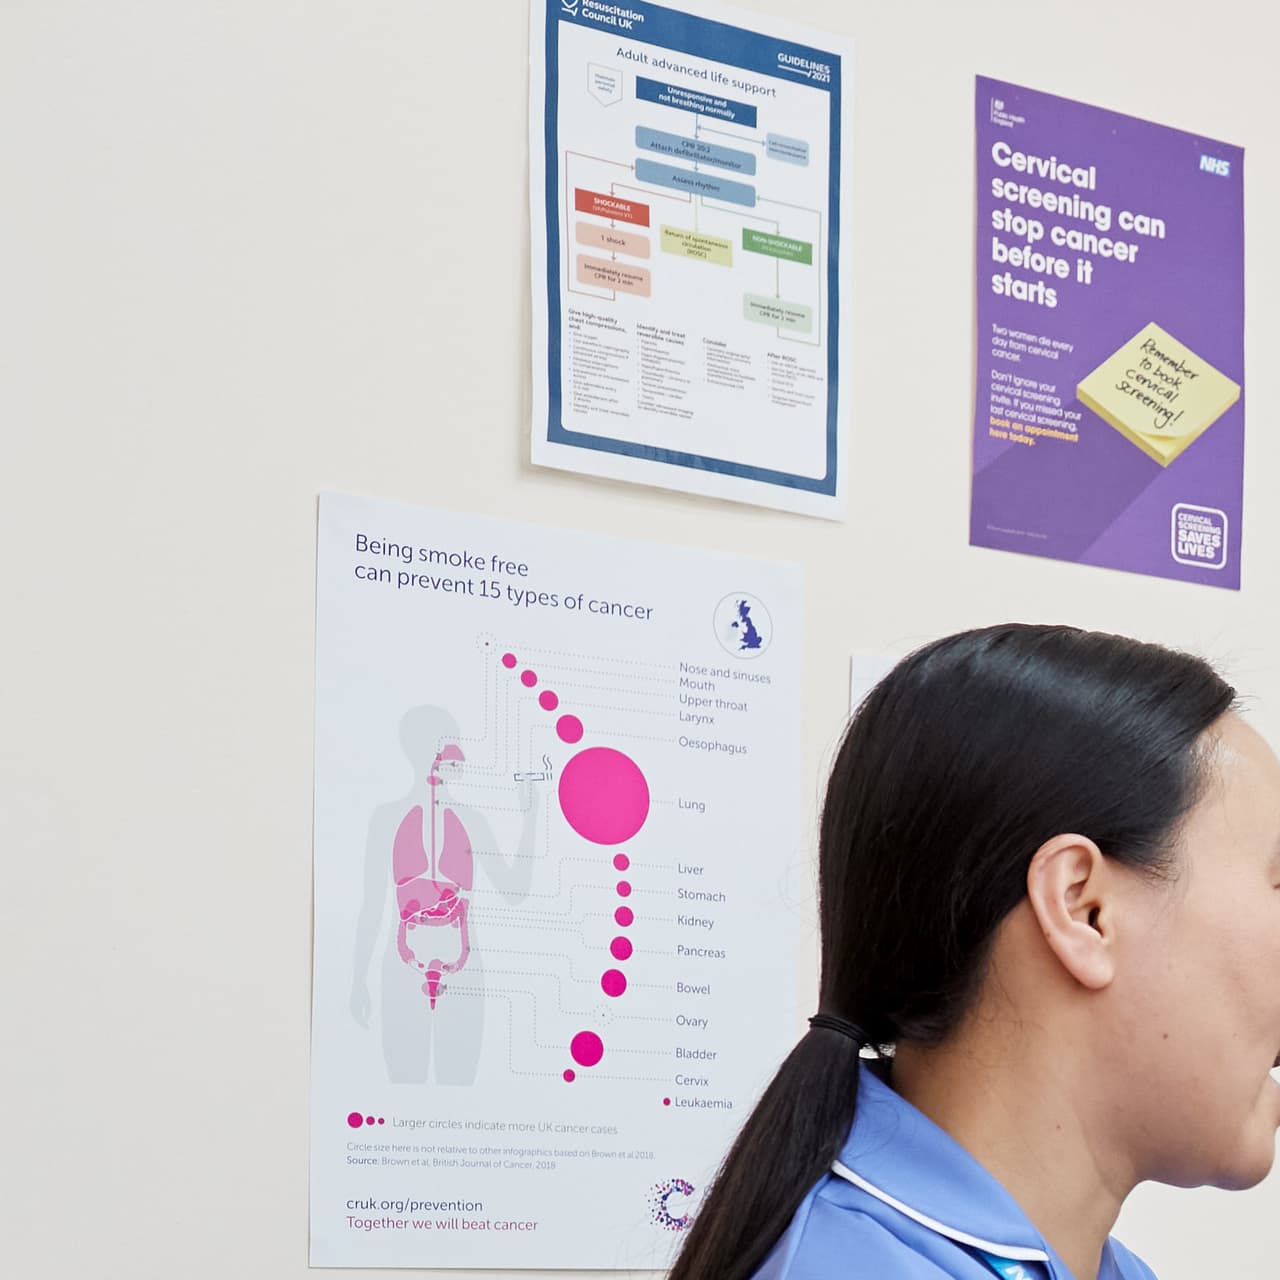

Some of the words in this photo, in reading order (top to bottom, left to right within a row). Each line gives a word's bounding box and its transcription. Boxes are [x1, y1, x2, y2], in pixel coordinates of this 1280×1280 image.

[582, 0, 645, 22] Resuscitation
[582, 8, 617, 26] Council
[618, 18, 633, 30] UK
[616, 47, 649, 64] Adult
[651, 58, 708, 80] advanced
[710, 71, 729, 86] life
[731, 79, 777, 98] support
[777, 52, 831, 74] GUIDELINES
[811, 71, 830, 83] 2021
[658, 94, 671, 103] not
[671, 95, 705, 112] breathing
[667, 86, 713, 104] Unresponsive
[991, 141, 1096, 191] Cervical
[1200, 155, 1230, 176] NHS
[991, 177, 1112, 232] screening
[1118, 210, 1166, 240] can
[991, 207, 1045, 244] stop
[1050, 225, 1139, 264] cancer
[991, 236, 1071, 279] before
[1076, 258, 1094, 285] it
[991, 271, 1058, 309] starts
[991, 323, 1008, 336] Two
[1008, 329, 1038, 343] women
[1038, 336, 1052, 347] die
[1052, 339, 1074, 353] every
[991, 336, 1008, 349] day
[1008, 339, 1027, 352] from
[1027, 345, 1059, 360] cervical
[1139, 338, 1199, 380] Remember
[1139, 357, 1152, 371] to
[1152, 365, 1182, 391] book
[1178, 529, 1222, 549] SAVES
[355, 533, 414, 564] Being
[418, 547, 486, 571] smoke
[490, 555, 529, 577] free
[1177, 541, 1216, 559] LIVES
[354, 565, 392, 583] can
[397, 571, 475, 596] prevent
[479, 579, 501, 599] 15
[506, 584, 559, 608] types
[563, 593, 584, 611] of
[587, 599, 654, 621] cancer
[679, 661, 708, 677] Nose
[709, 667, 731, 679] and
[732, 671, 772, 685] sinuses
[679, 677, 716, 692] Mouth
[679, 693, 713, 708] Upper
[715, 698, 749, 713] throat
[679, 710, 715, 726] Larynx
[678, 735, 748, 756] Oesophagus
[678, 797, 706, 814] Lung
[677, 862, 705, 876] Liver
[677, 887, 727, 904] Stomach
[677, 914, 715, 931] Kidney
[677, 944, 726, 960] Pancreas
[676, 981, 711, 996] Bowel
[675, 1014, 709, 1030] Ovary
[675, 1047, 717, 1061] Bladder
[675, 1073, 710, 1087] Cervix
[675, 1096, 733, 1110] Leukaemia
[392, 1116, 426, 1130] Larger
[428, 1118, 463, 1130] circles
[465, 1119, 506, 1132] indicate
[508, 1122, 536, 1133] more
[537, 1122, 553, 1133] UK
[554, 1123, 590, 1134] cancer
[591, 1125, 619, 1135] cases
[346, 1141, 373, 1153] Circle
[373, 1143, 391, 1153] size
[391, 1143, 411, 1153] here
[412, 1144, 421, 1154] is
[421, 1144, 436, 1154] not
[437, 1144, 468, 1155] relative
[468, 1146, 478, 1155] to
[478, 1145, 502, 1156] other
[502, 1147, 553, 1159] infographics
[553, 1148, 578, 1158] based
[578, 1150, 590, 1158] on
[591, 1149, 617, 1159] Brown
[617, 1151, 626, 1159] et
[381, 1156, 410, 1167] Brown
[411, 1157, 421, 1167] et
[432, 1157, 459, 1168] British
[459, 1158, 492, 1169] Journal
[492, 1158, 502, 1169] of
[346, 1196, 483, 1215] cruk.org/prevention
[346, 1215, 410, 1232] Together
[411, 1219, 433, 1230] we
[435, 1217, 459, 1230] will
[461, 1218, 491, 1231] beat
[493, 1220, 539, 1232] cancer
